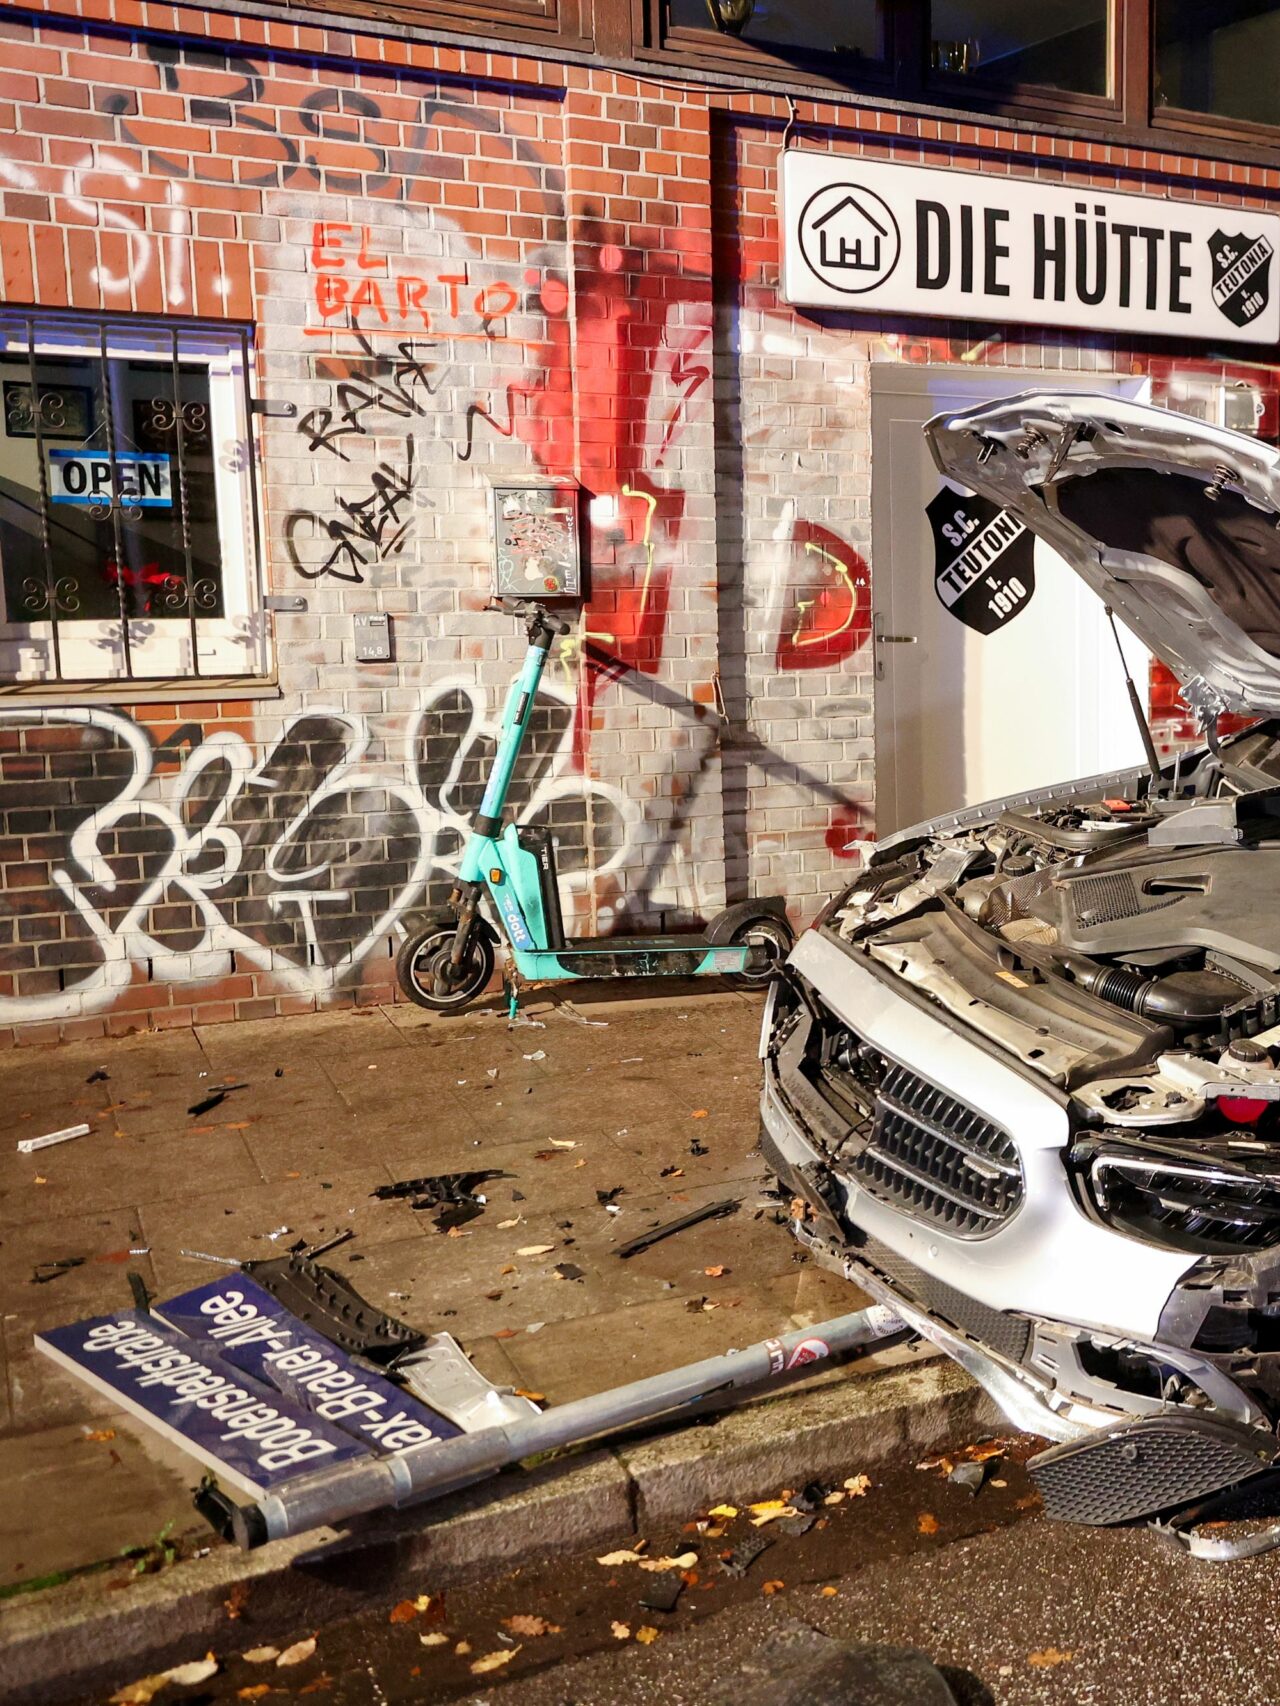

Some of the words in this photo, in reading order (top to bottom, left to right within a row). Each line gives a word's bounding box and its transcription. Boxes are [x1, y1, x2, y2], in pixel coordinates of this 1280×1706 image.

[311, 223, 388, 269] EL
[916, 199, 1010, 297] DIE
[1033, 202, 1192, 314] HÜTTE
[1216, 244, 1239, 269] S.C.
[1215, 242, 1269, 299] TEUTONIA
[314, 274, 519, 331] BARTO
[1241, 291, 1264, 318] 1910
[62, 460, 161, 496] OPEN
[941, 509, 980, 547] S.C.
[941, 511, 1022, 595] TEUTONI
[985, 576, 1002, 590] v.
[988, 577, 1027, 619] 1910
[541, 846, 549, 870] TIER
[507, 913, 526, 943] dott
[199, 1291, 443, 1456] ax-Brauer-Allee
[82, 1320, 338, 1471] Bodenstedtstraße
